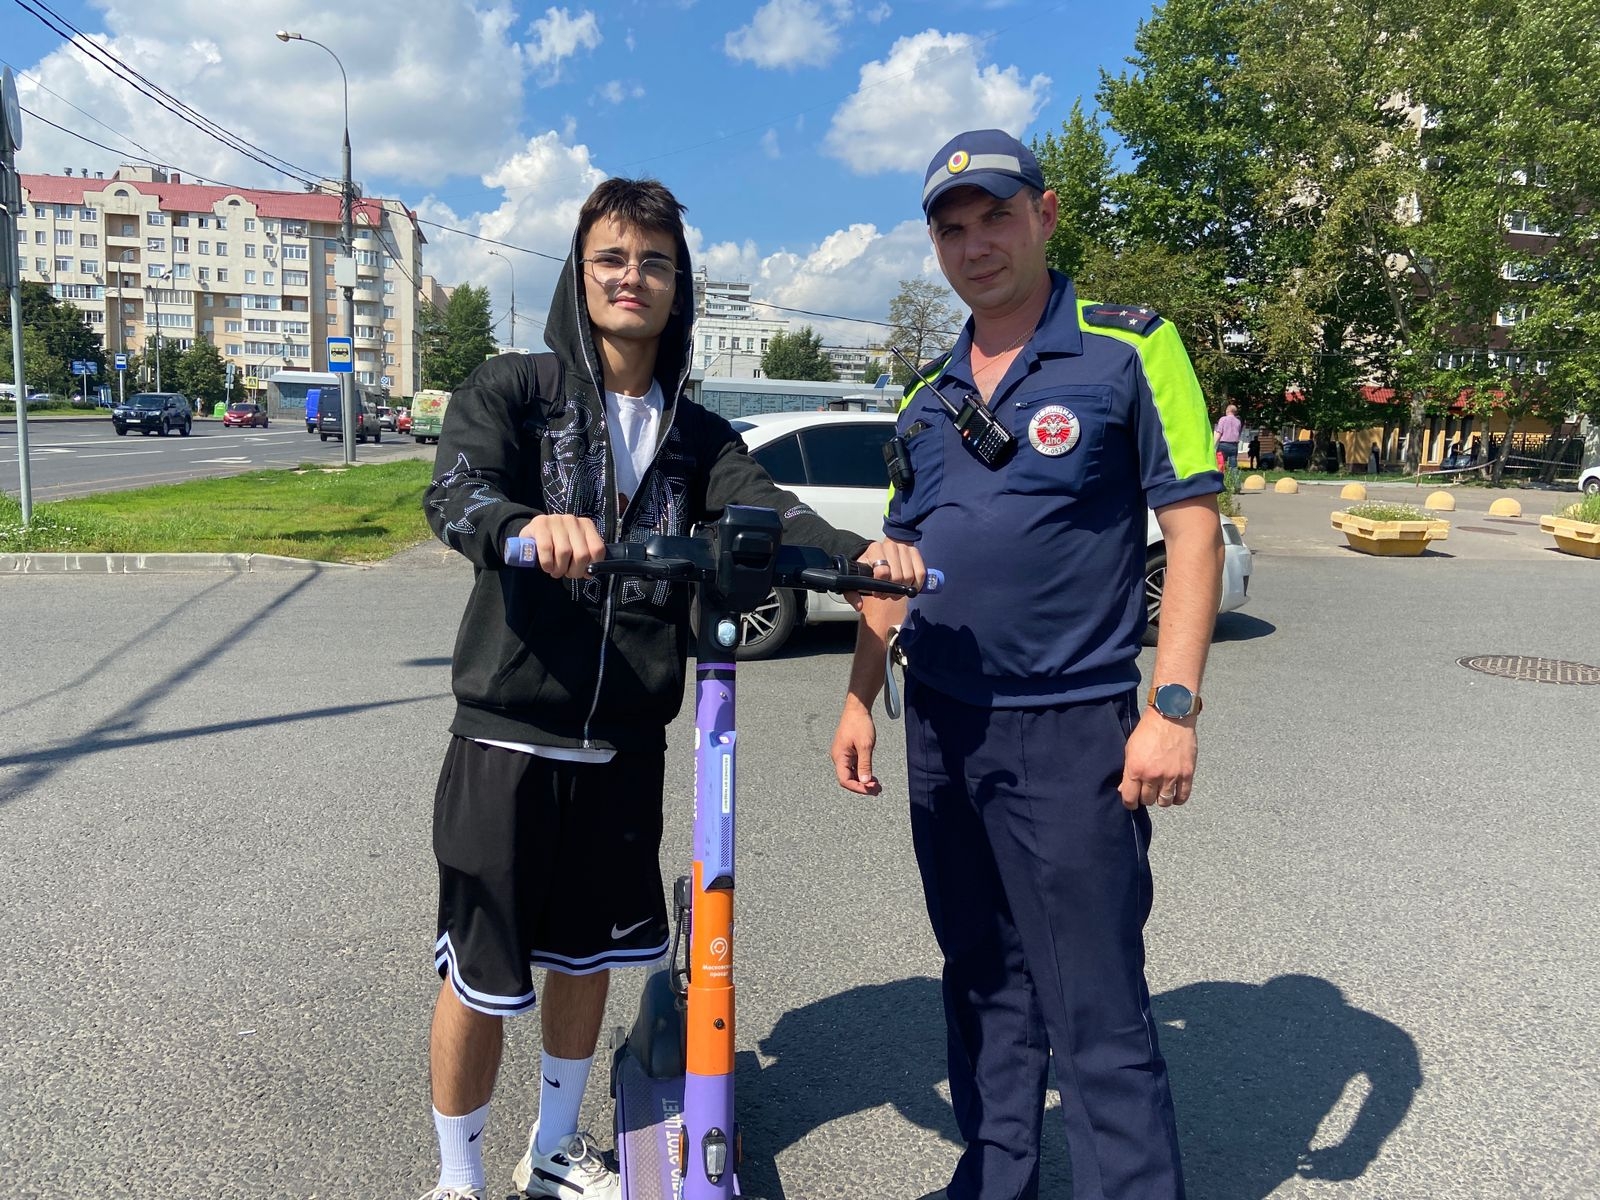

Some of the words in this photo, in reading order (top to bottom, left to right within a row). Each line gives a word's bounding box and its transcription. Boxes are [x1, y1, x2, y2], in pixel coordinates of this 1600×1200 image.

[1035, 407, 1074, 421] ПОЛИЦИЯ
[1045, 437, 1062, 445] ДПС
[662, 1098, 684, 1129] ЦВЕТ
